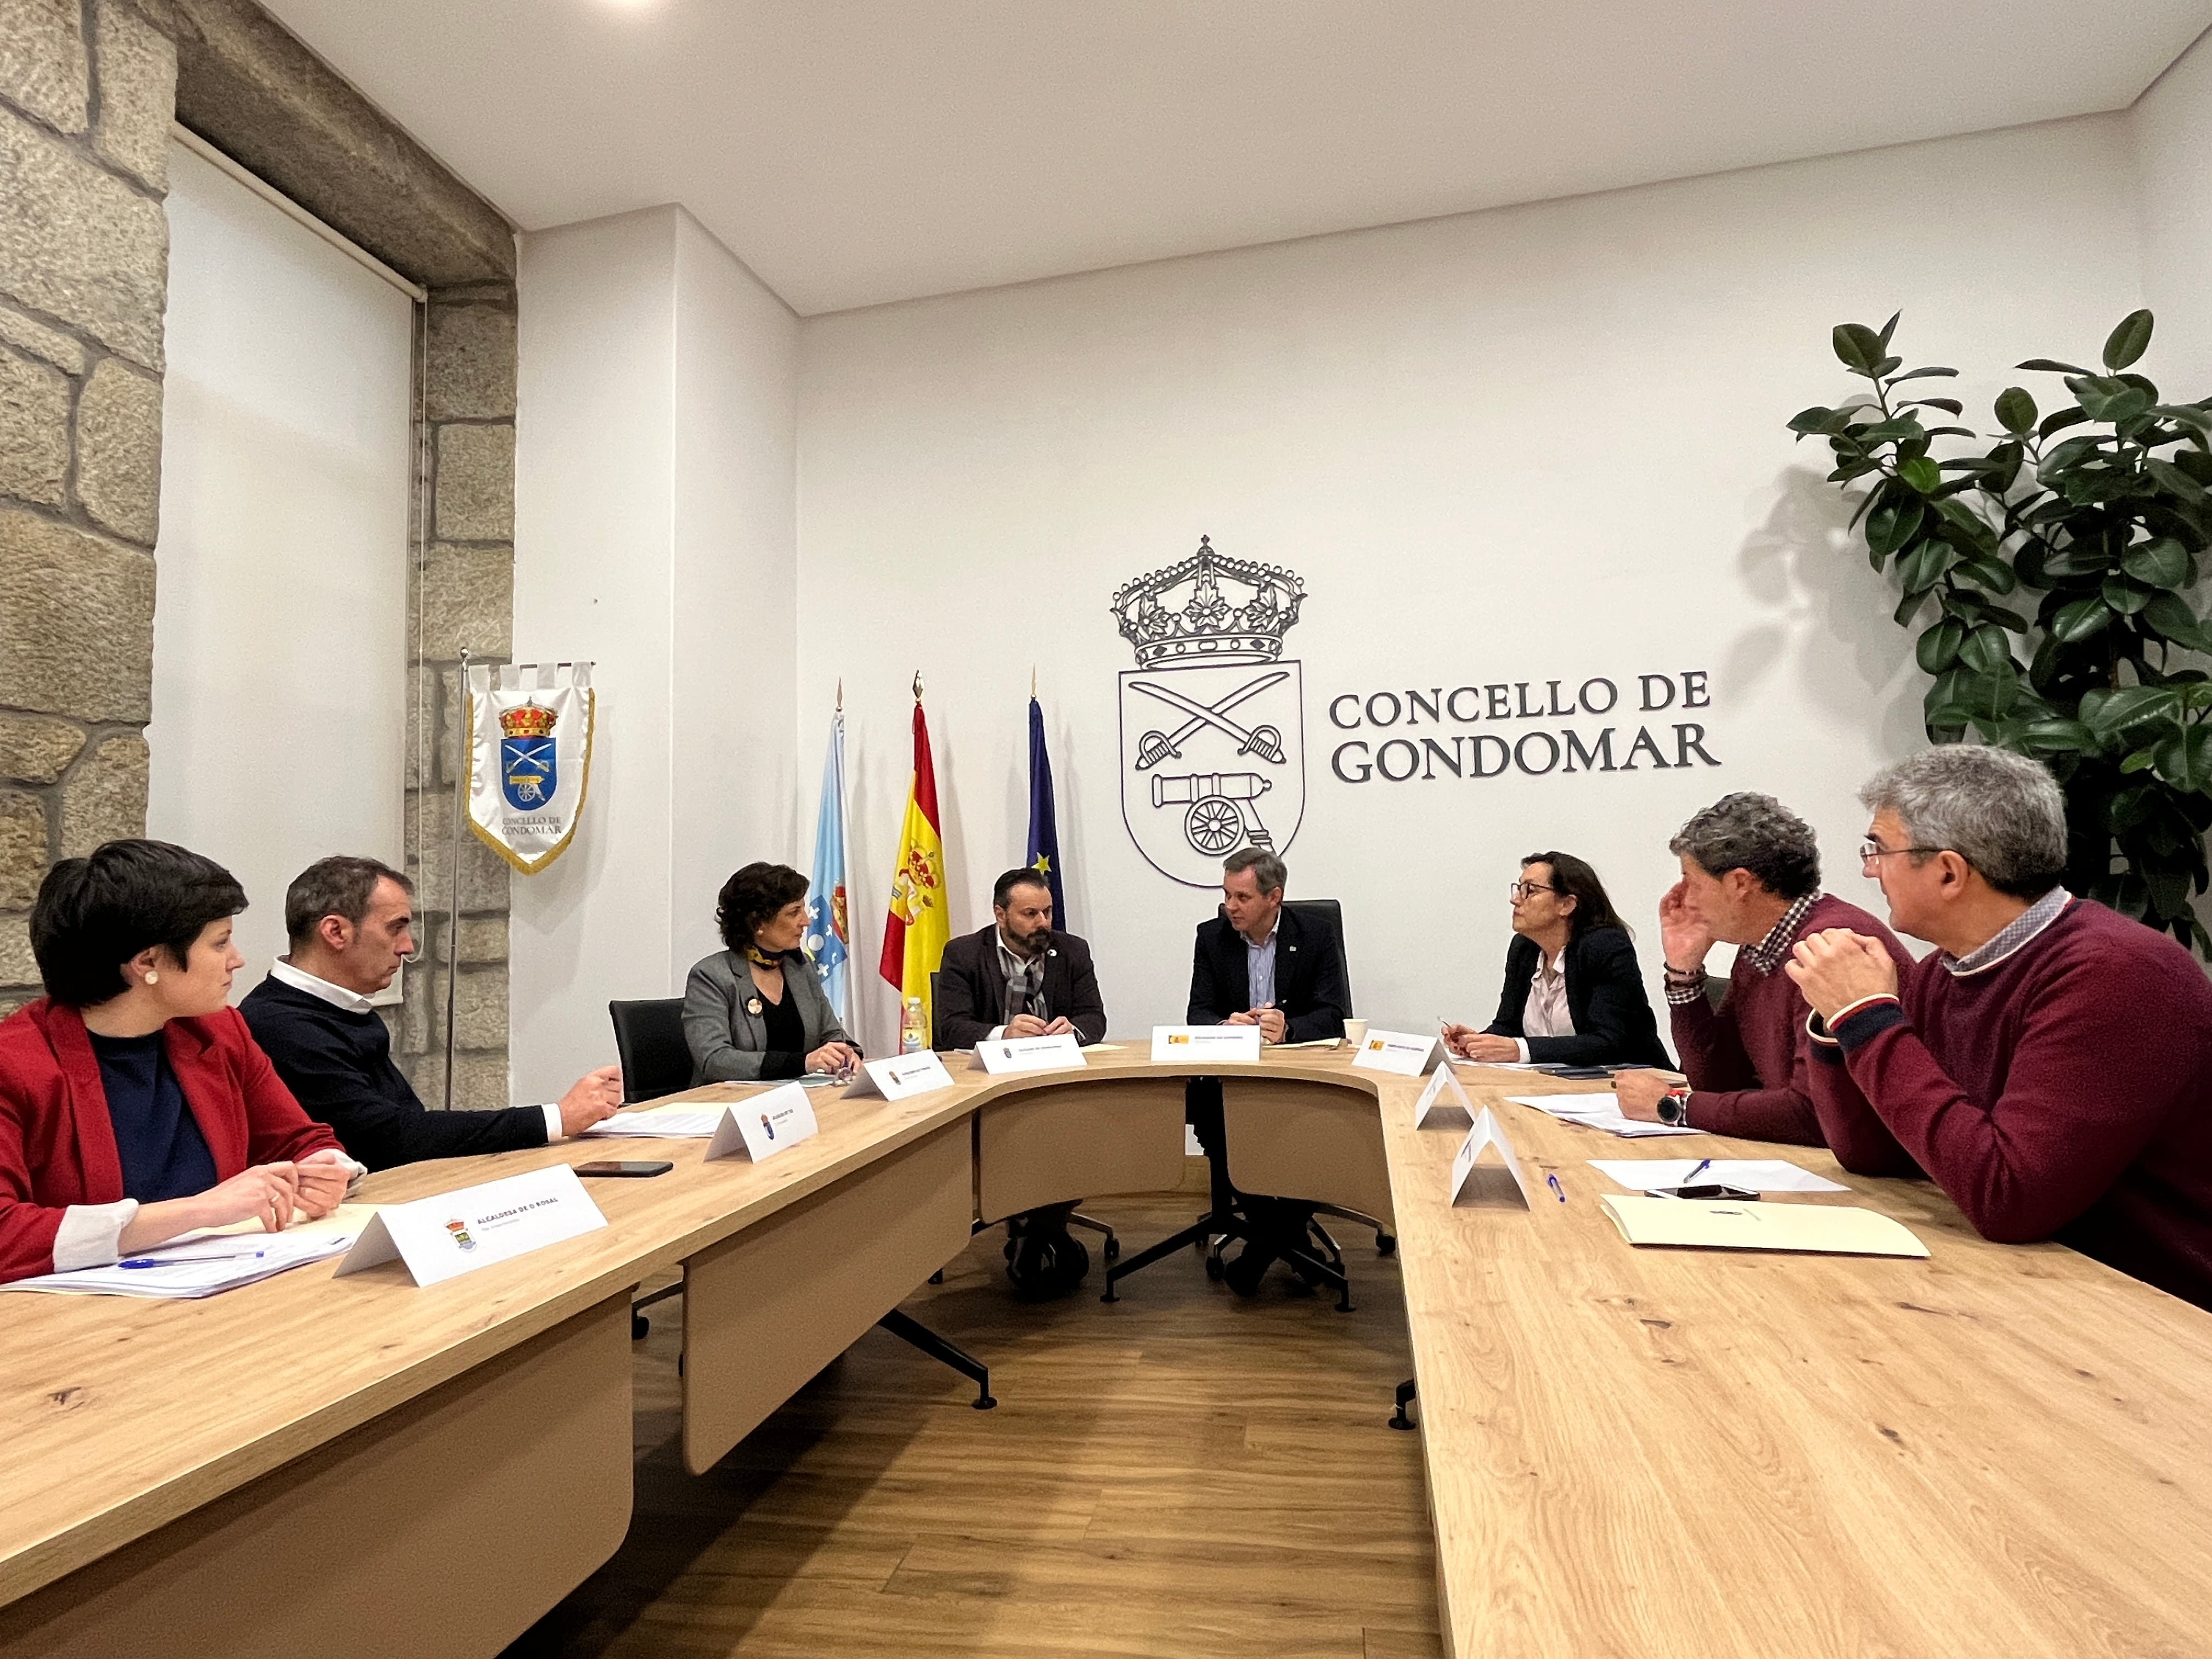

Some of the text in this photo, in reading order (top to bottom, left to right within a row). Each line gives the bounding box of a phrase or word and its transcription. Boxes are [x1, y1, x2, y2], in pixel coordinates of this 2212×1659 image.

[1329, 670, 1711, 729] CONCELLO DE
[1331, 723, 1722, 783] GONDOMAR
[477, 1209, 517, 1224] ALCALDESA
[535, 1197, 558, 1207] ROSAL
